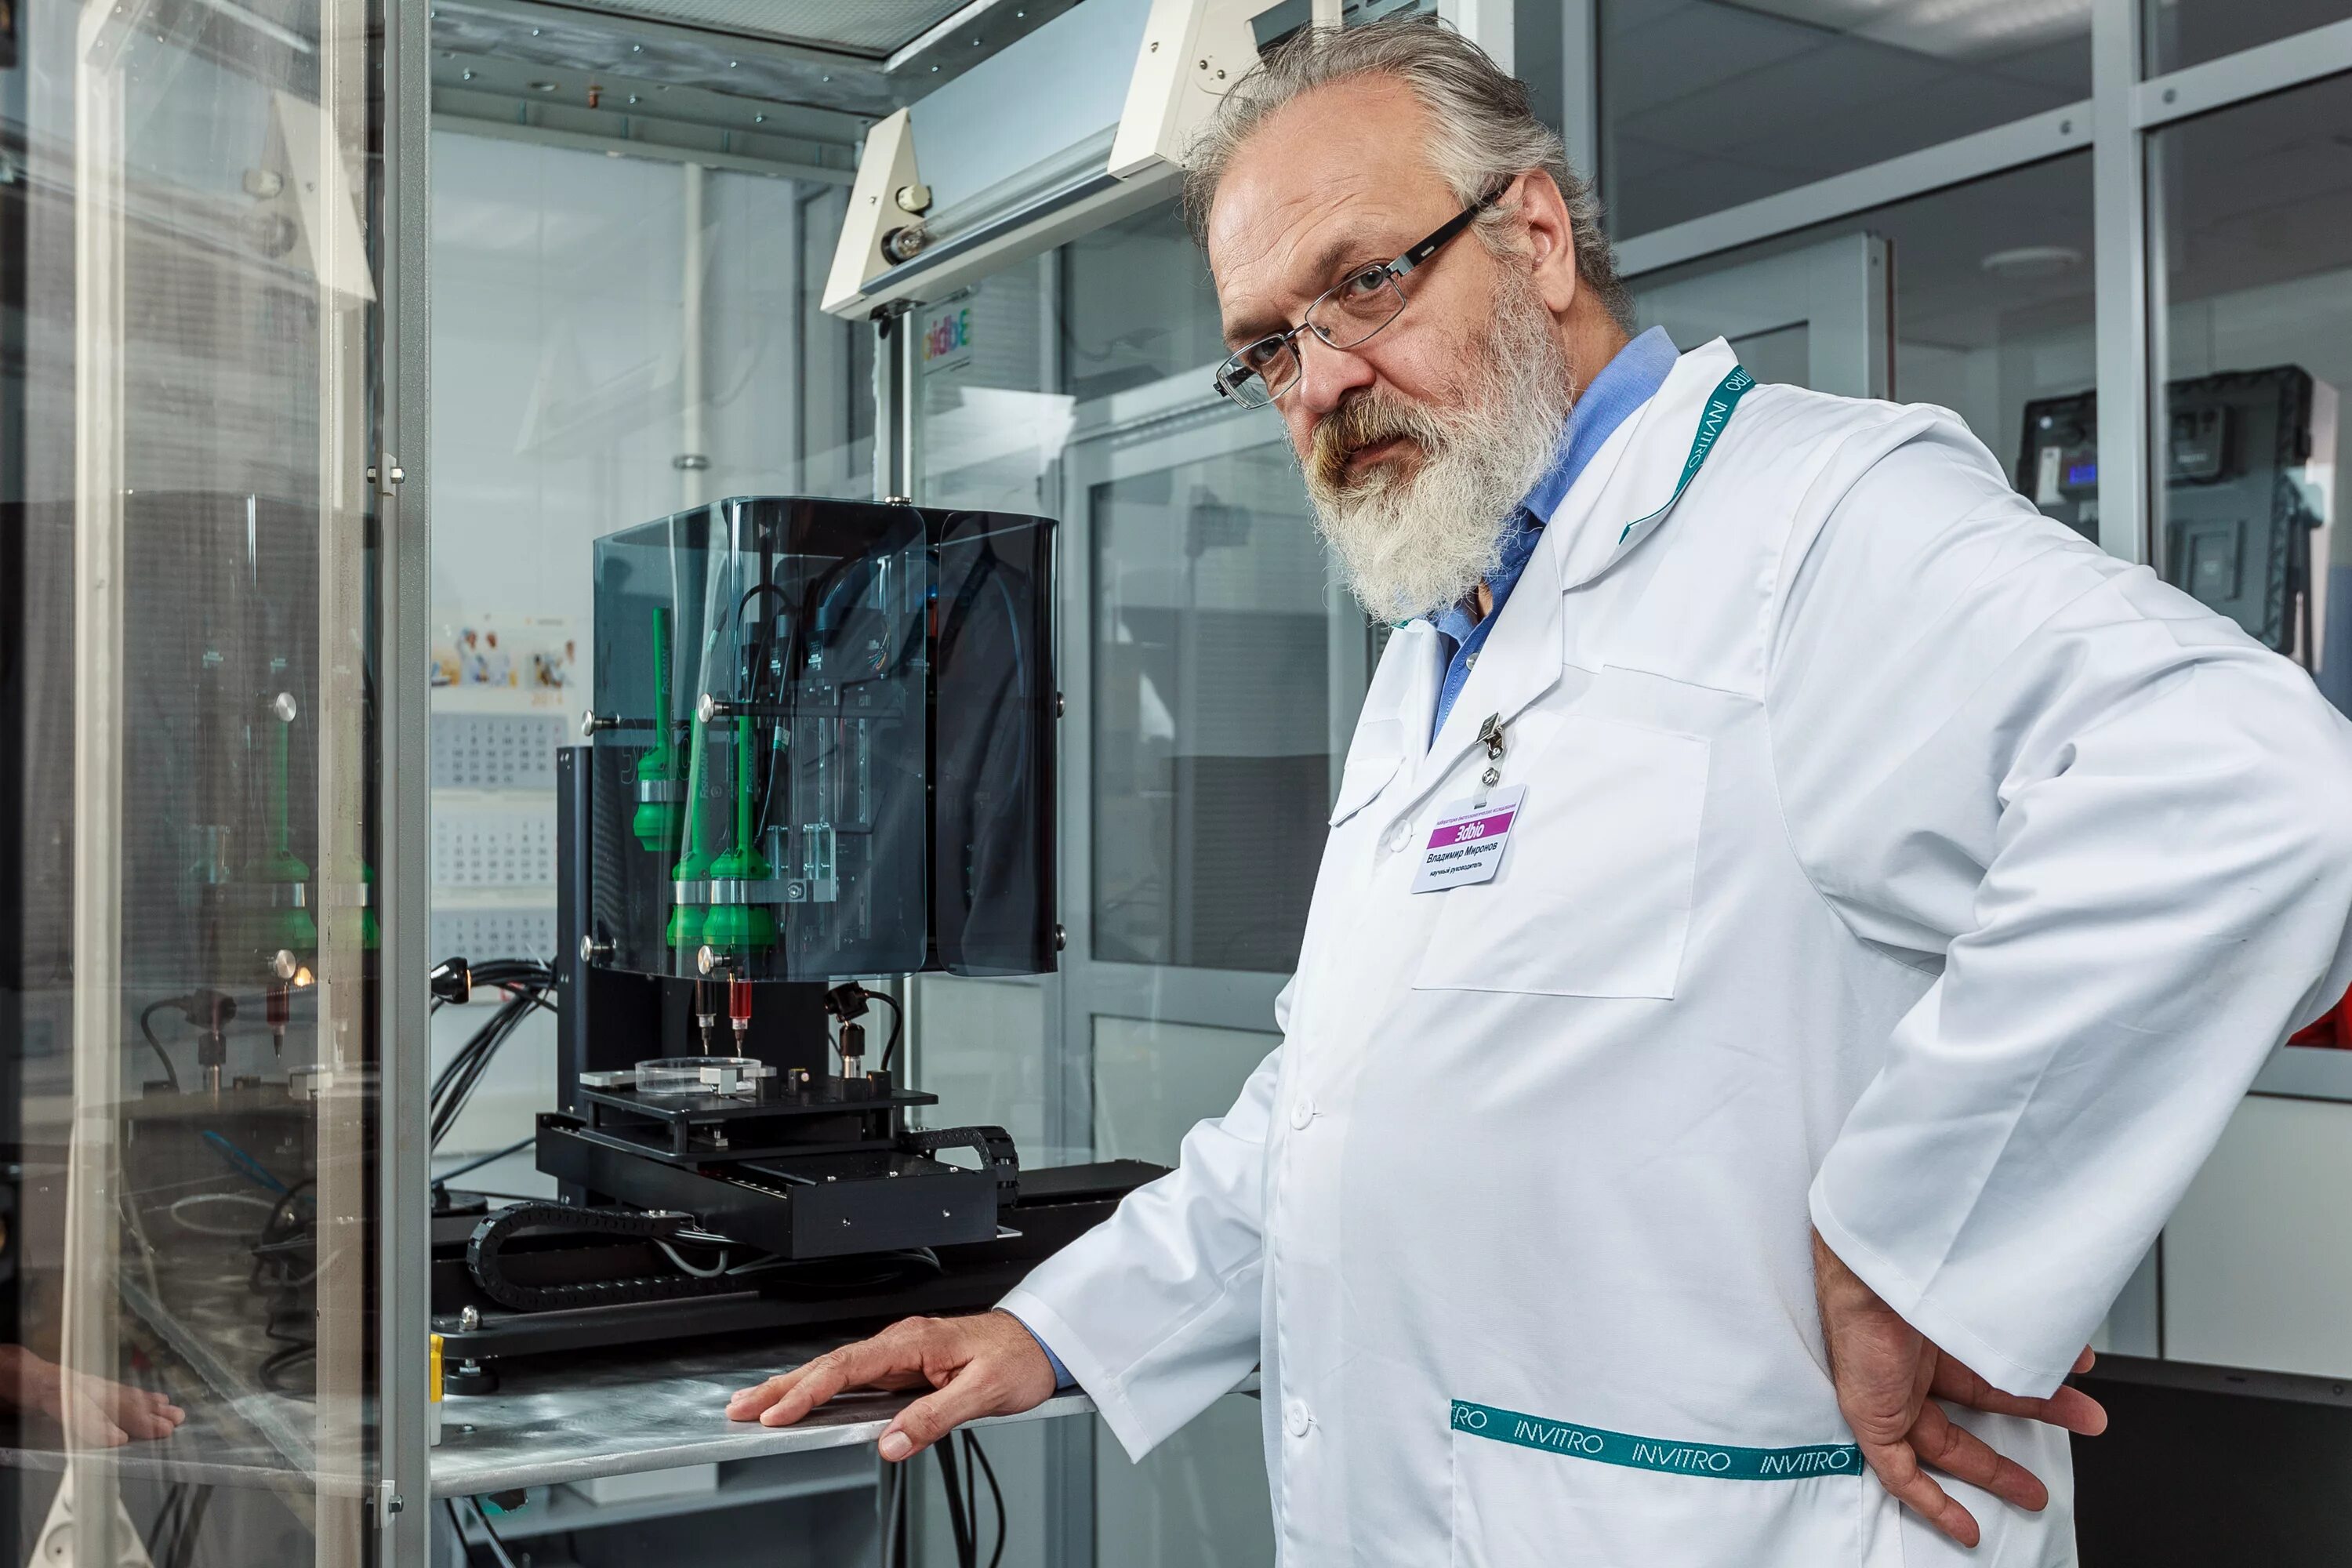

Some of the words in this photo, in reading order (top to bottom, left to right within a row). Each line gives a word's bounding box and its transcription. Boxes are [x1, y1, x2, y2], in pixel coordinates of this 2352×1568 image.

[1689, 400, 1728, 469] INVITRO
[1454, 821, 1485, 842] 3dbio
[1426, 849, 1464, 863] Владимир
[1464, 841, 1498, 857] Миронов
[1429, 866, 1450, 877] научный
[1450, 862, 1483, 874] руководитель
[1514, 1419, 1604, 1454] INVITRO
[1632, 1443, 1731, 1472] INVITRO
[1759, 1450, 1850, 1475] INVITRO
